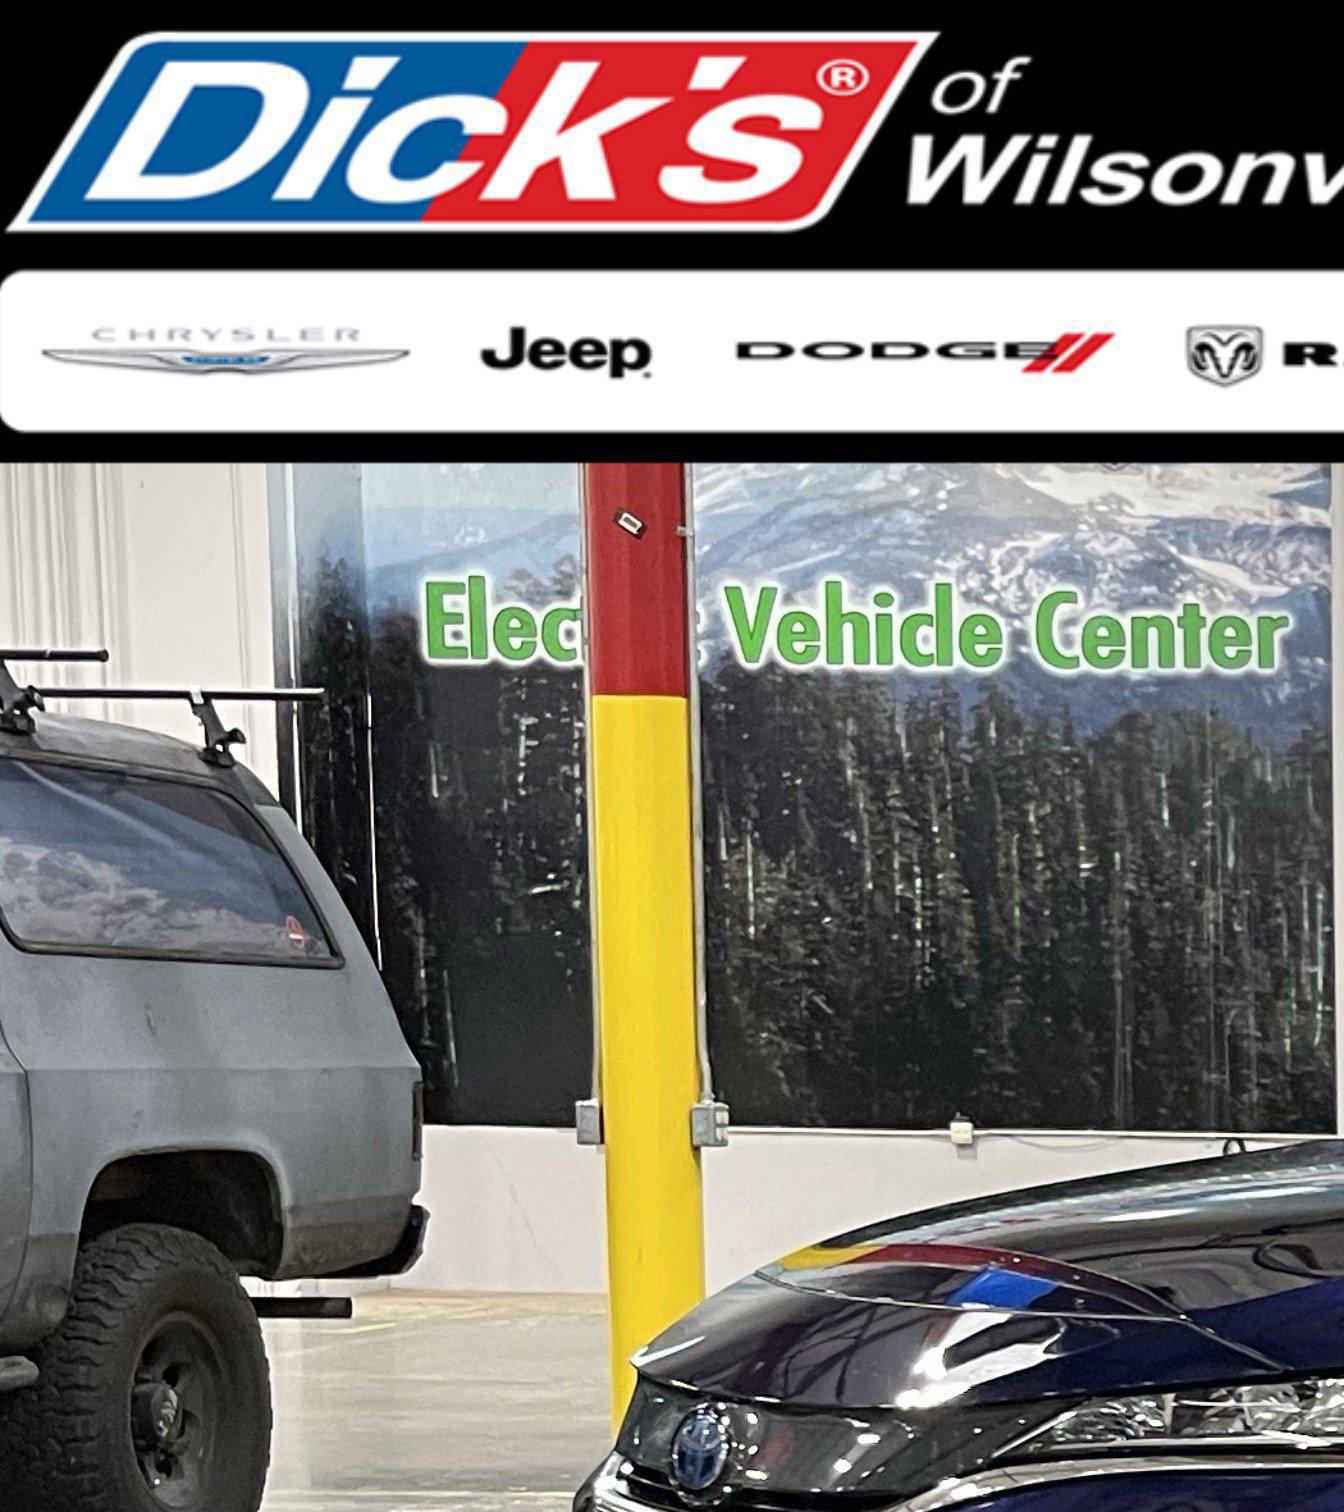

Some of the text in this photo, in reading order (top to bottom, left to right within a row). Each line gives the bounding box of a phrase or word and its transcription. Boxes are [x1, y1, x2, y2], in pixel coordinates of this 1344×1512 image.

[425, 575, 1290, 669] Elec Vehicle Center
